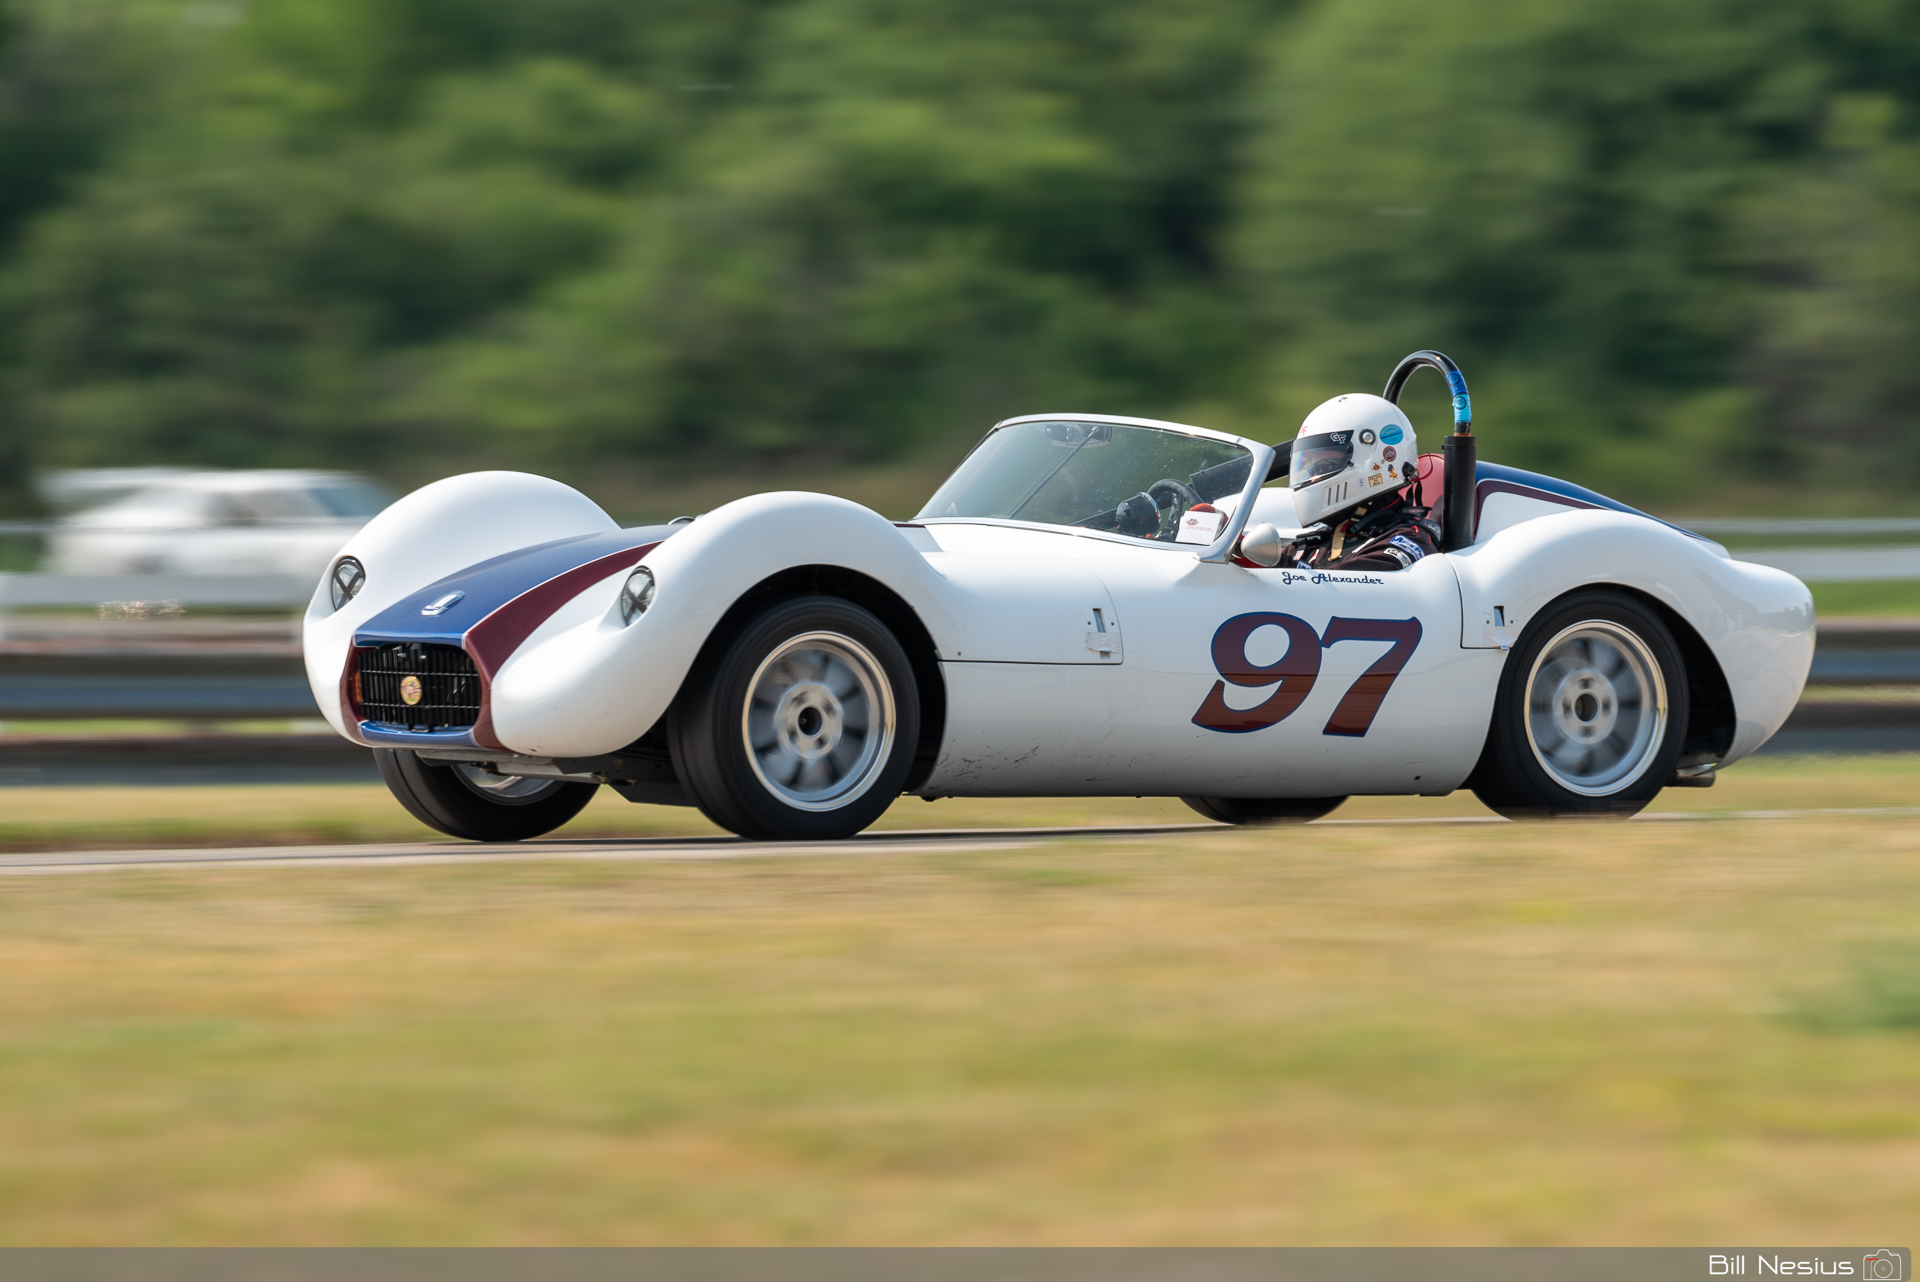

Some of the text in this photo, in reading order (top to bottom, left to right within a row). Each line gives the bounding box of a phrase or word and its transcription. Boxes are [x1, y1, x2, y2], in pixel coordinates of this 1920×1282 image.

[1282, 571, 1385, 585] Joe Alexander
[1191, 611, 1423, 737] 97
